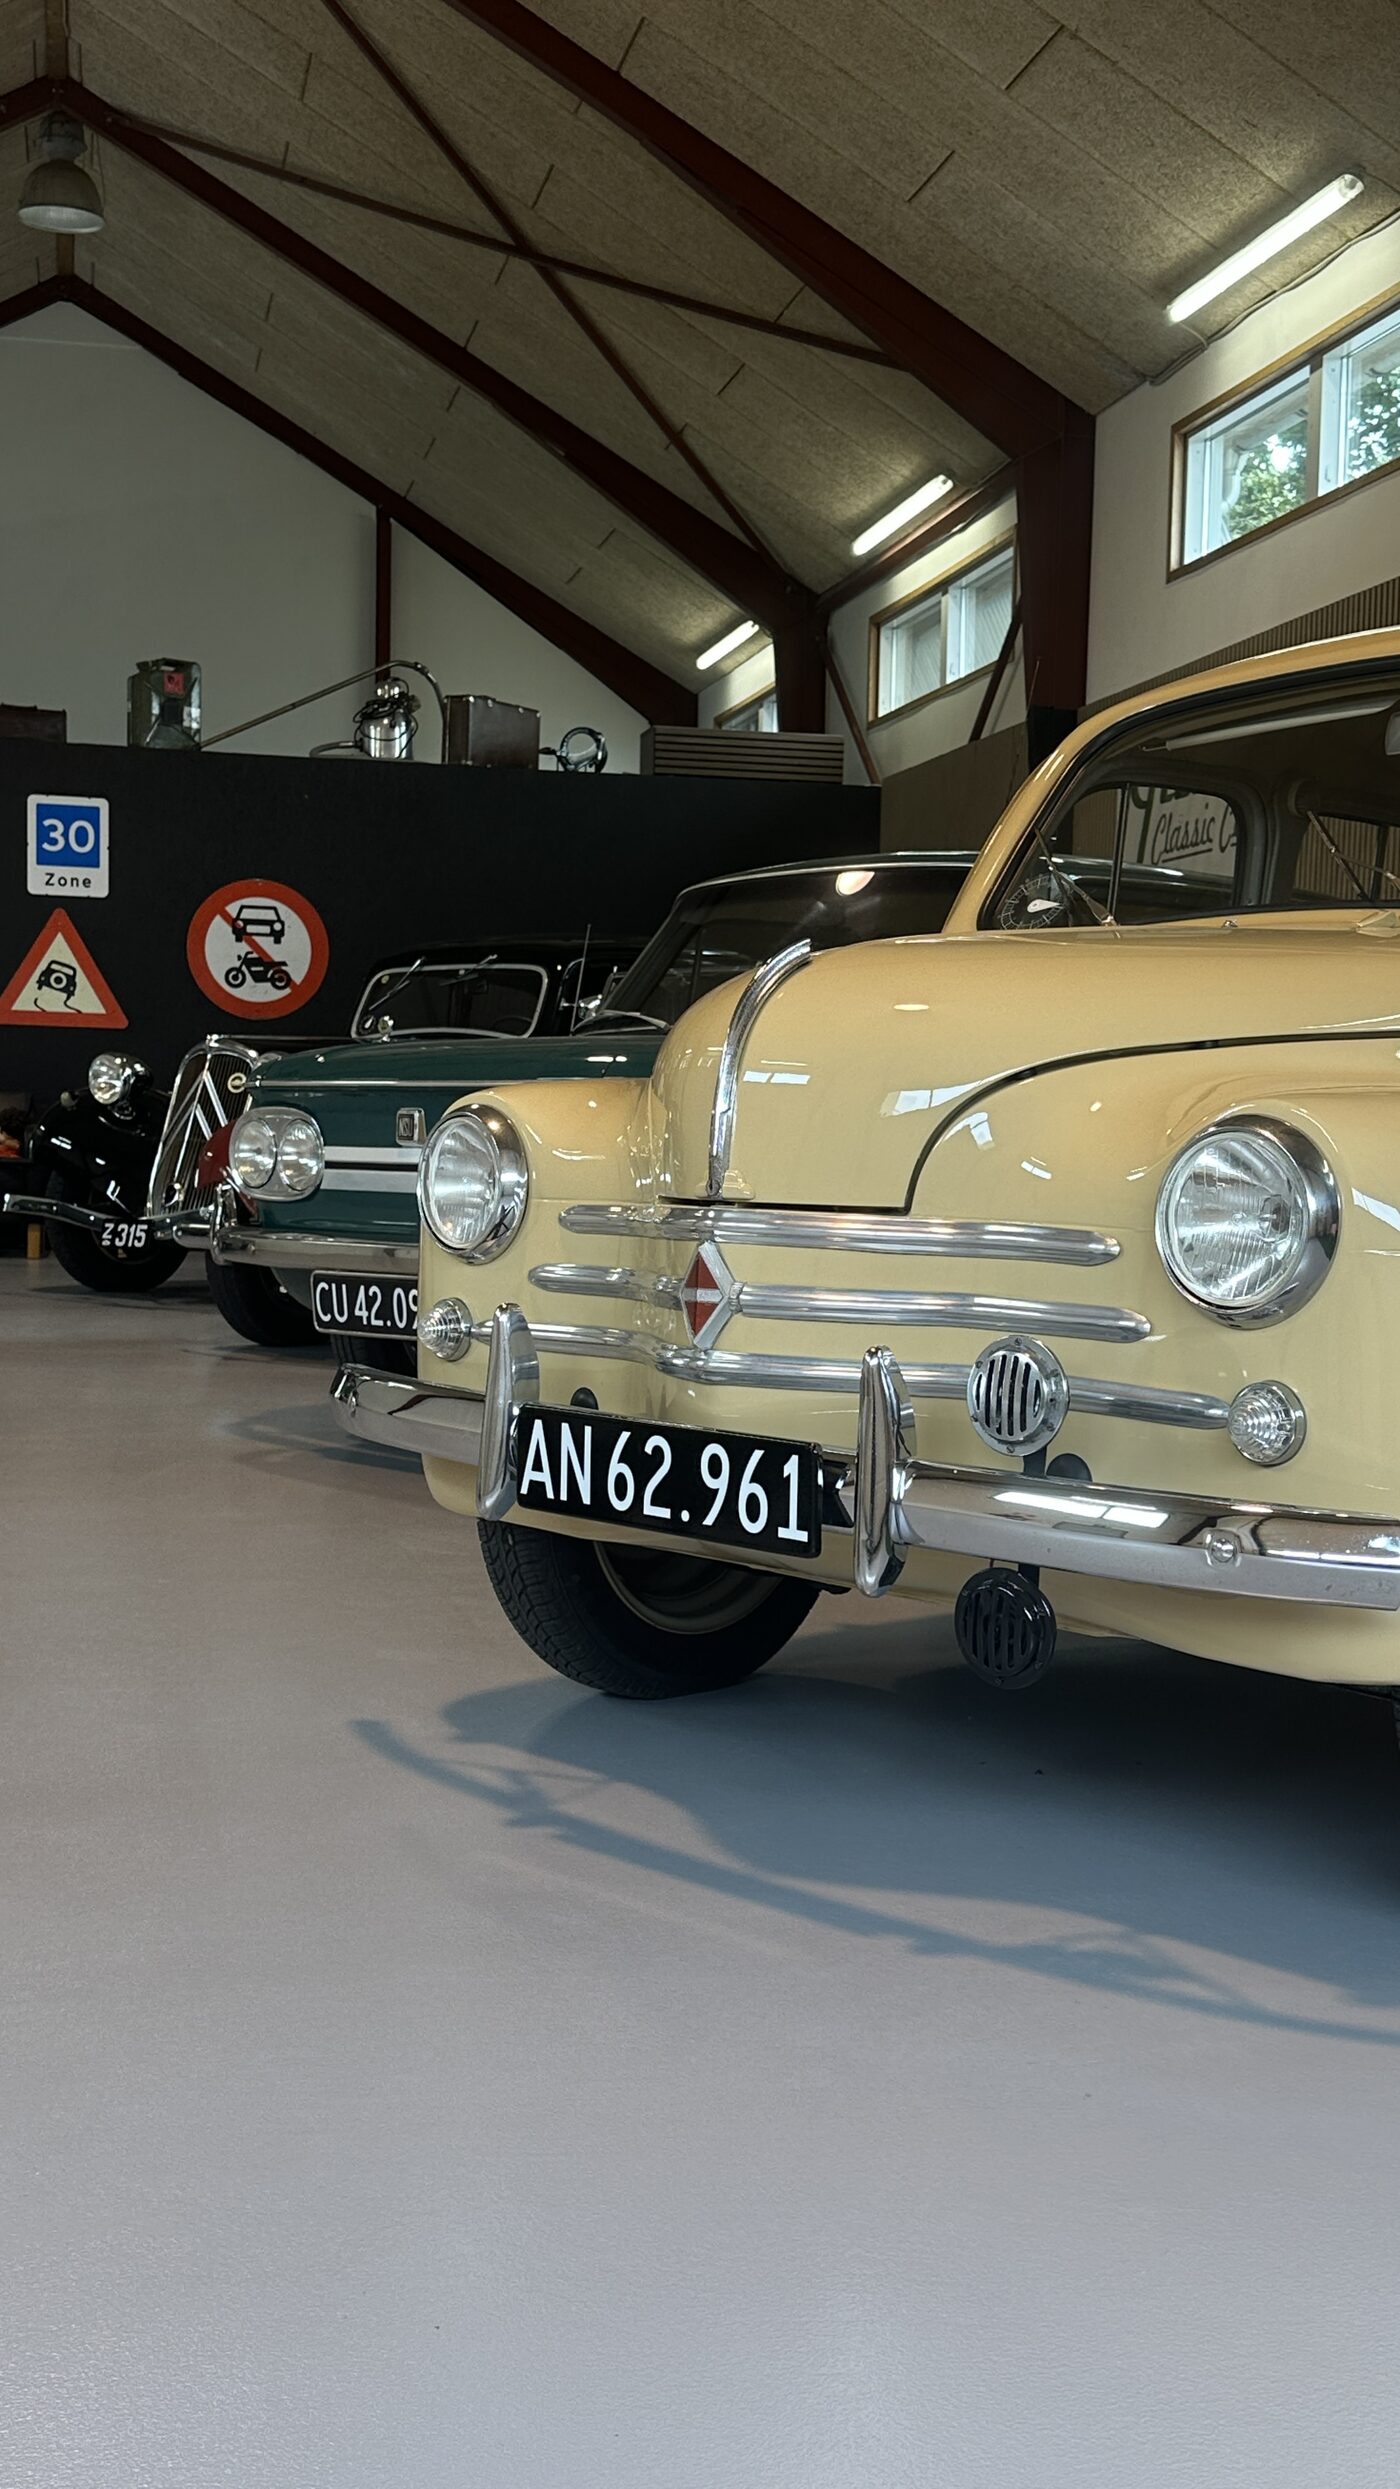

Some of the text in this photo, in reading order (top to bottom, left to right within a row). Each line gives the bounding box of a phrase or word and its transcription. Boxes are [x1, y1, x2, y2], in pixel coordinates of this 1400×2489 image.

[42, 818, 95, 853] 30
[1151, 803, 1215, 865] Classic
[1219, 804, 1238, 854] C
[45, 872, 91, 888] Zone
[115, 1223, 148, 1248] 315
[315, 1282, 348, 1323] CU
[520, 1418, 809, 1544] AN 62.961
